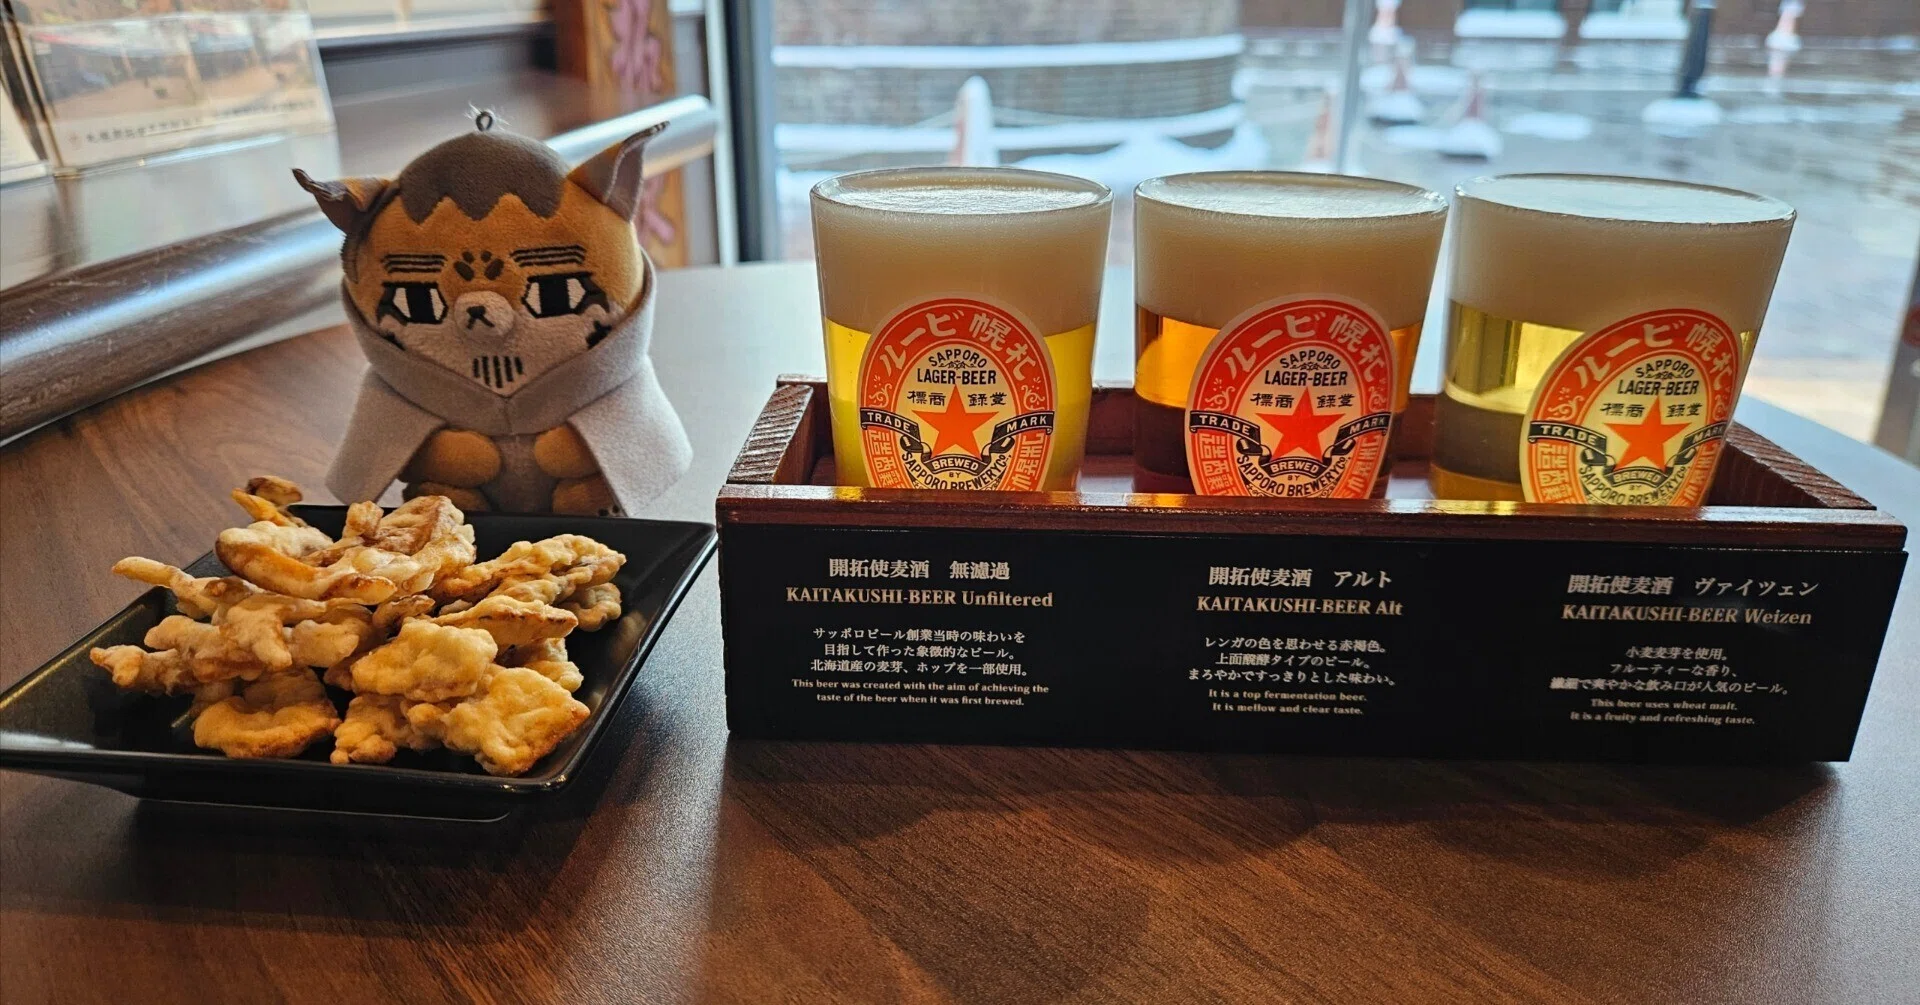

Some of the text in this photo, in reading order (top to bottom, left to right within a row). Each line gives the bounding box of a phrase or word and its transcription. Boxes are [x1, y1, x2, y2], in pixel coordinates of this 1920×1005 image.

[928, 349, 988, 368] SAPPORO
[1279, 349, 1341, 369] SAPPORO
[1635, 358, 1694, 378] SAPPORO
[917, 368, 997, 385] LAGER-BEER
[1264, 370, 1348, 387] LAGER-BEER
[1617, 379, 1699, 396] LAGER-BEER
[867, 412, 1047, 432] TRADE MARK
[1199, 415, 1385, 435] TRADE MARK
[1540, 425, 1598, 445] TRADE
[901, 451, 948, 490] SAPPORO
[950, 465, 1002, 490] BREWERY
[931, 458, 979, 471] BREWED
[1270, 460, 1320, 473] BREWED
[1236, 455, 1285, 495] SAPPORO
[1287, 465, 1342, 497] BREWERY
[1579, 465, 1627, 505] SAPPORO
[1613, 470, 1662, 483] BREWED
[829, 559, 1010, 580] 開拓使麦酒 無濾過
[1208, 566, 1392, 588] 開拓使麦酒 アルト
[1567, 575, 1819, 597] 開拓使麦酒 ヴァイツェン
[786, 587, 1053, 607] KAITAKUSHI-BEER Unfiltered
[1196, 596, 1403, 615] KAITAKUSHI-BEER Alt
[1561, 604, 1812, 624] KAITAKUSHI-BEER Weizen
[792, 679, 1048, 694] This beer was created with the aim of achieving the
[1209, 689, 1217, 697] It
[1220, 689, 1230, 698] is
[1243, 690, 1261, 700] top
[1264, 690, 1336, 700] fermentation
[1340, 693, 1367, 701] beer.
[816, 693, 841, 701] taste
[844, 693, 855, 702] of
[857, 694, 873, 702] the
[875, 694, 898, 703] beer
[900, 694, 927, 703] when
[930, 695, 937, 704] it
[962, 696, 982, 705] first
[984, 696, 1024, 705] brewed.
[1212, 703, 1363, 714] It is mellow and clear taste.
[1591, 699, 1737, 710] This beer uses wheat malt.
[1570, 712, 1580, 720] It
[1583, 712, 1593, 720] is
[1604, 712, 1636, 723] fruity
[1640, 714, 1661, 722] and
[1663, 714, 1721, 725] refreshing
[1725, 715, 1755, 724] taste.
